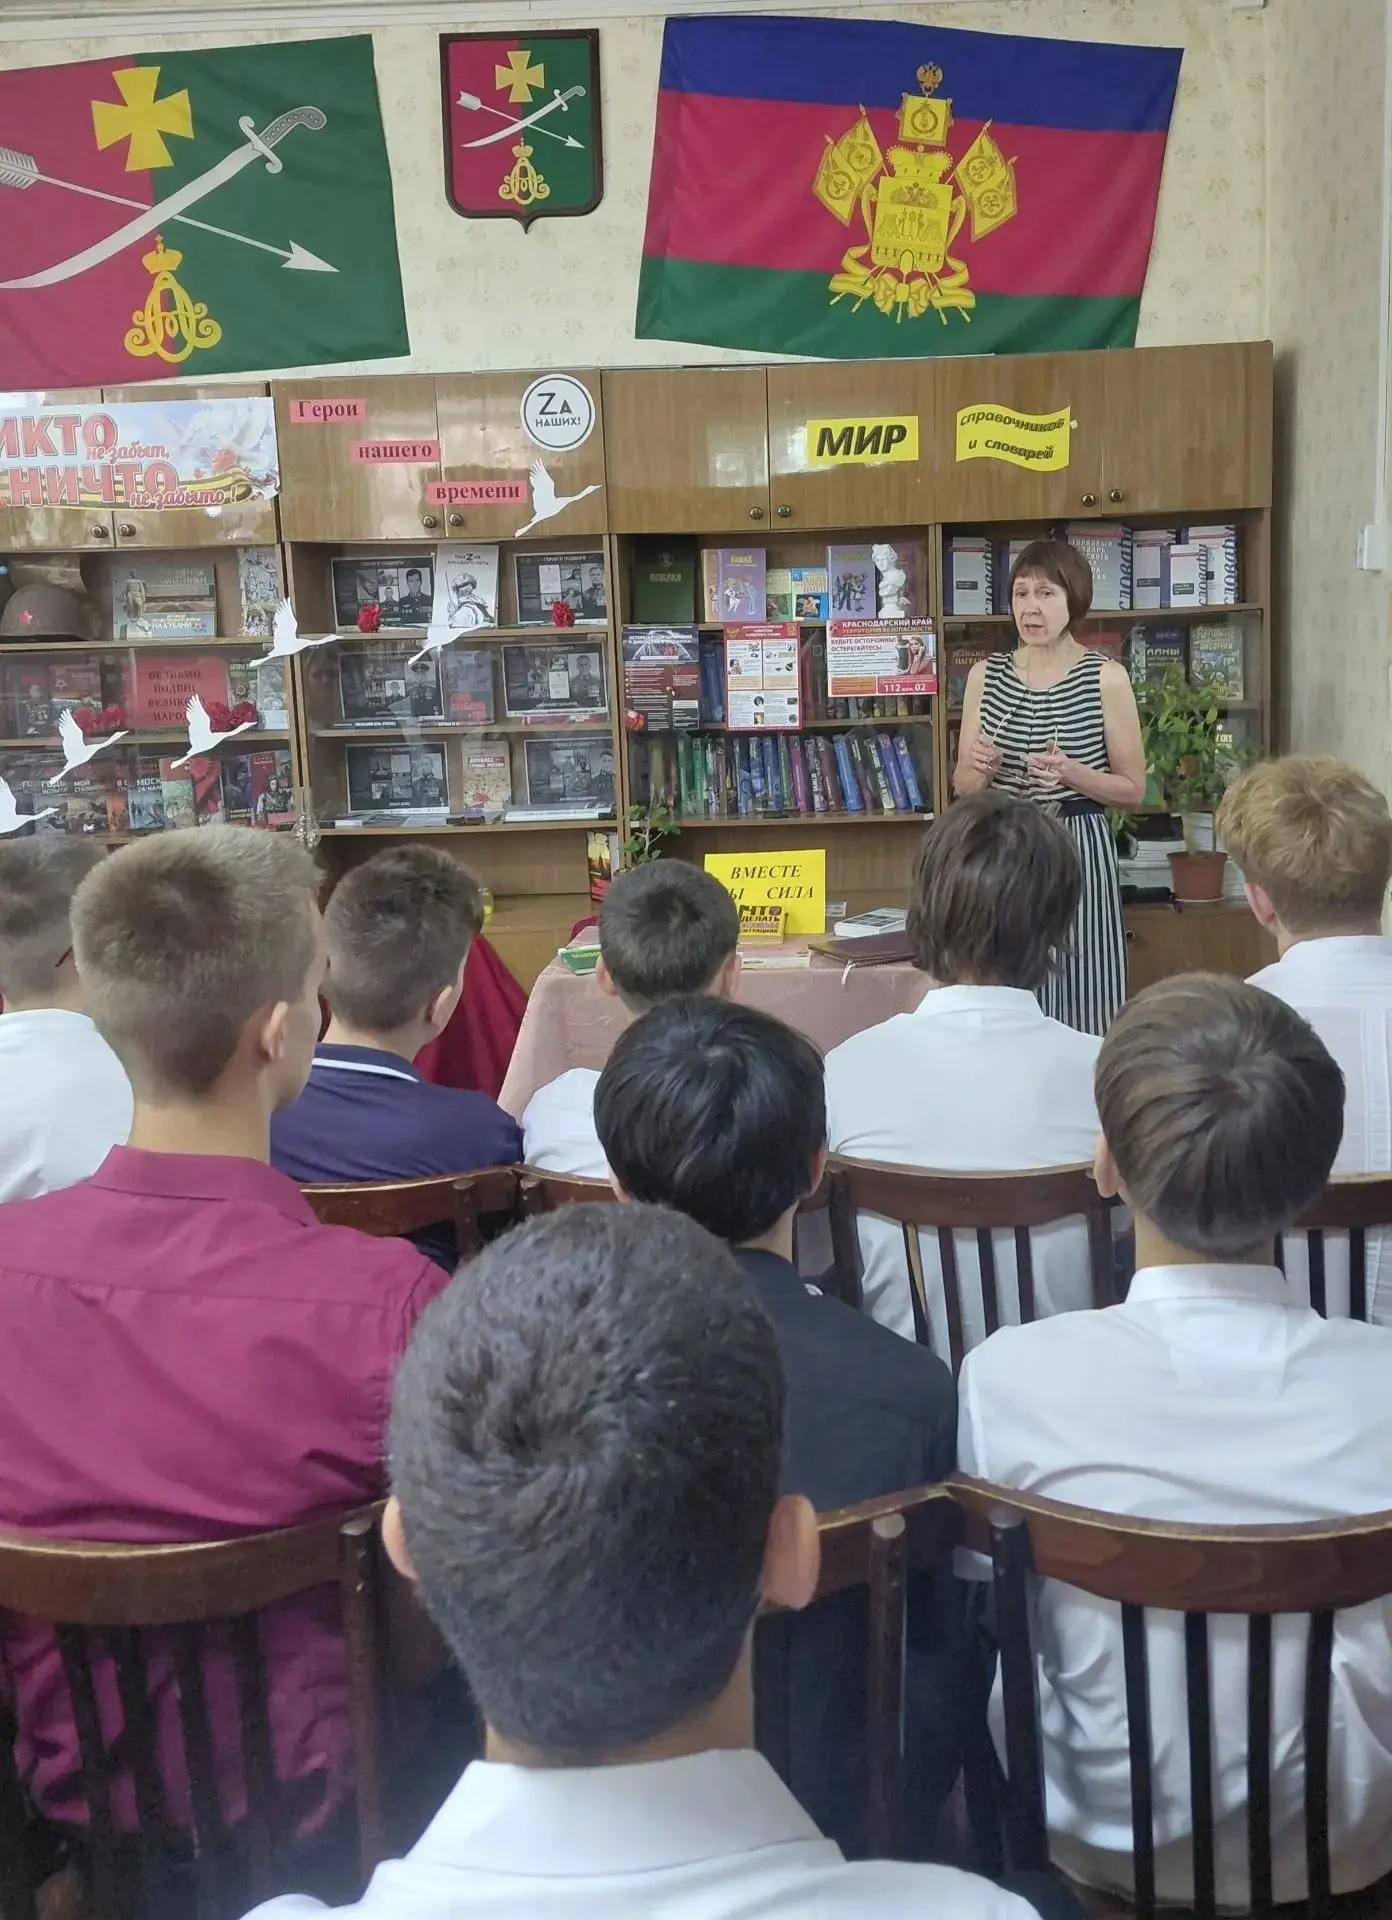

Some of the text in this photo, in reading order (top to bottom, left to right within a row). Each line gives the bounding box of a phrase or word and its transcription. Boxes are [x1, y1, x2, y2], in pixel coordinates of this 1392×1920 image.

[299, 400, 358, 422] Герои
[535, 416, 582, 428] НАШИХ!
[960, 410, 1065, 433] справочников
[0, 413, 118, 458] ИКТО
[816, 424, 908, 457] МИР
[359, 443, 433, 460] нашего
[968, 439, 1054, 461] и словарей
[7, 461, 180, 507] НИЧТО
[435, 484, 521, 503] времени
[842, 617, 933, 628] КРАСНОДАРСКИЙ КРАЙ
[842, 627, 882, 635] ТЕРРИТОРИЯ
[1147, 648, 1180, 656] АЙНЫ
[884, 683, 901, 692] 112
[914, 683, 926, 692] 02
[153, 710, 187, 722] НАРО
[731, 865, 801, 880] ВМЕСТЕ
[767, 886, 814, 899] СИЛА
